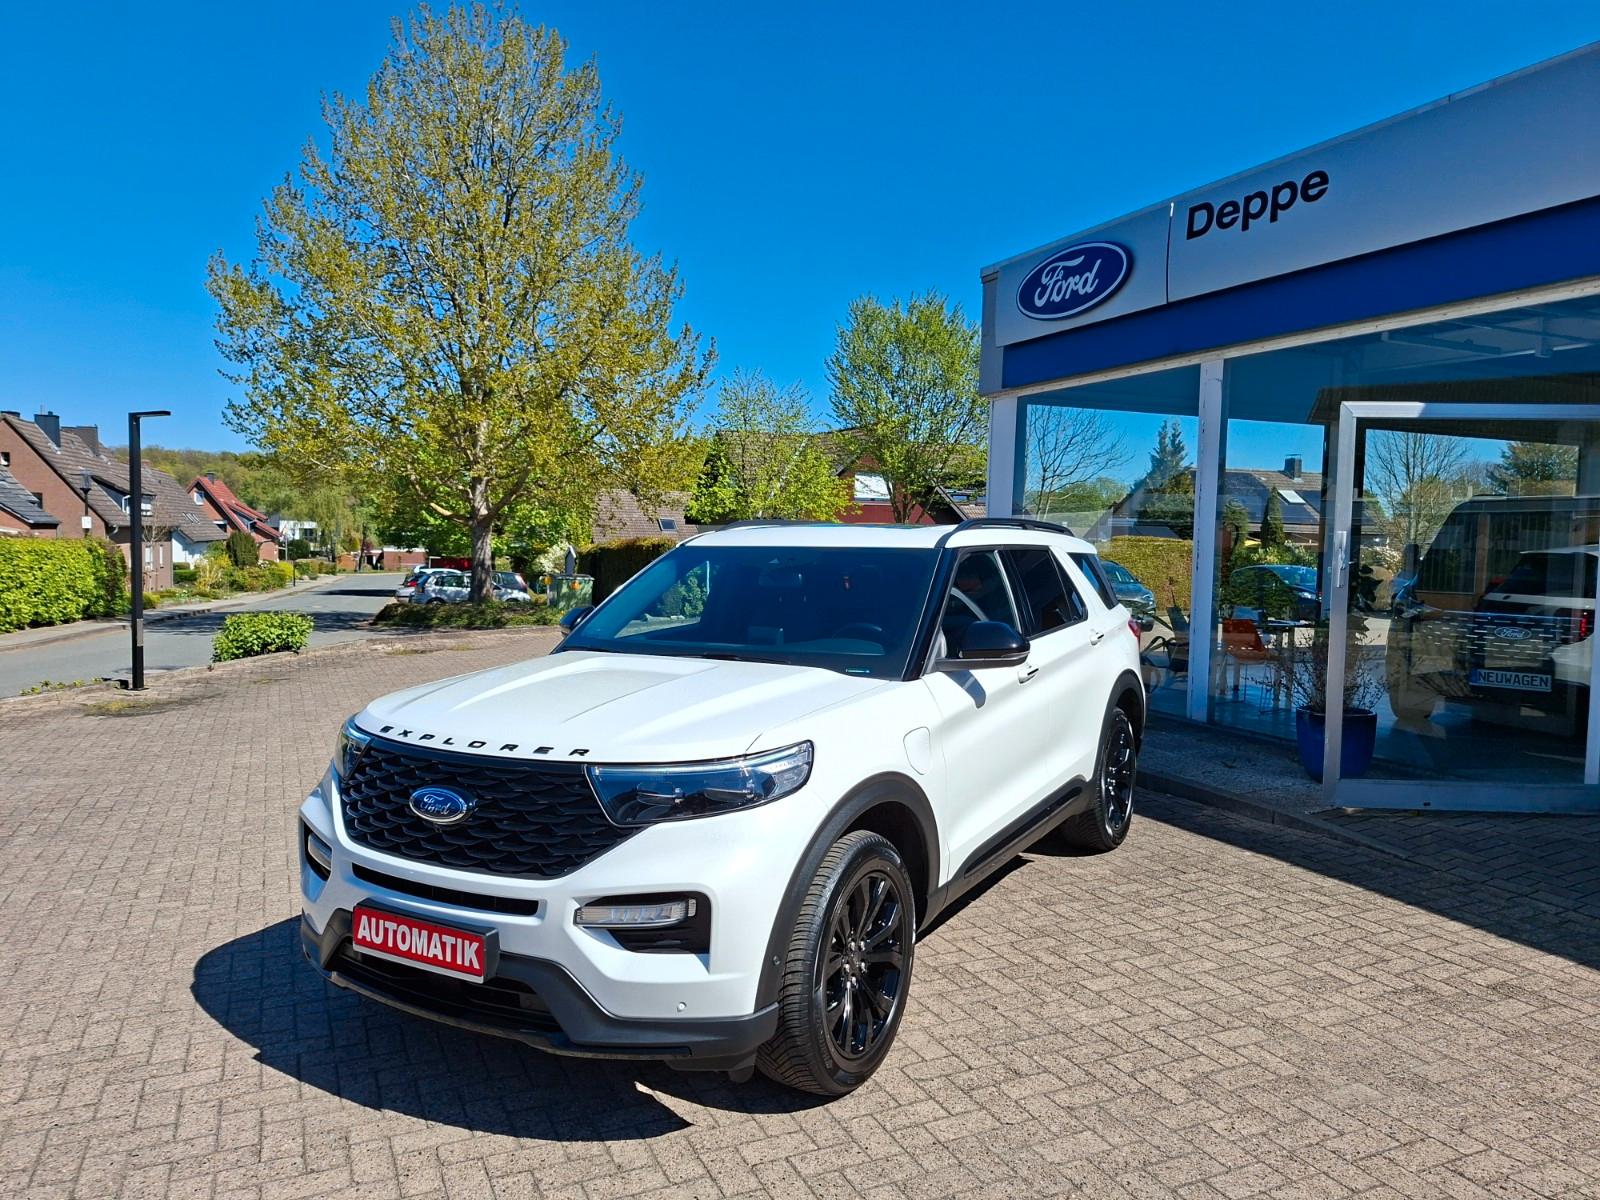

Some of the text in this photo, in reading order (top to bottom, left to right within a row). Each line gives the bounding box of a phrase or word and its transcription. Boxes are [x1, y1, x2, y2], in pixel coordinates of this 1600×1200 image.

[1186, 170, 1329, 240] Deppe
[1034, 255, 1102, 308] Ford
[1501, 628, 1525, 638] Ford
[1479, 671, 1549, 687] NEUWAGEN
[379, 725, 590, 757] EXPLORER
[420, 794, 451, 815] Ford
[357, 915, 480, 970] AUTOMATIK
